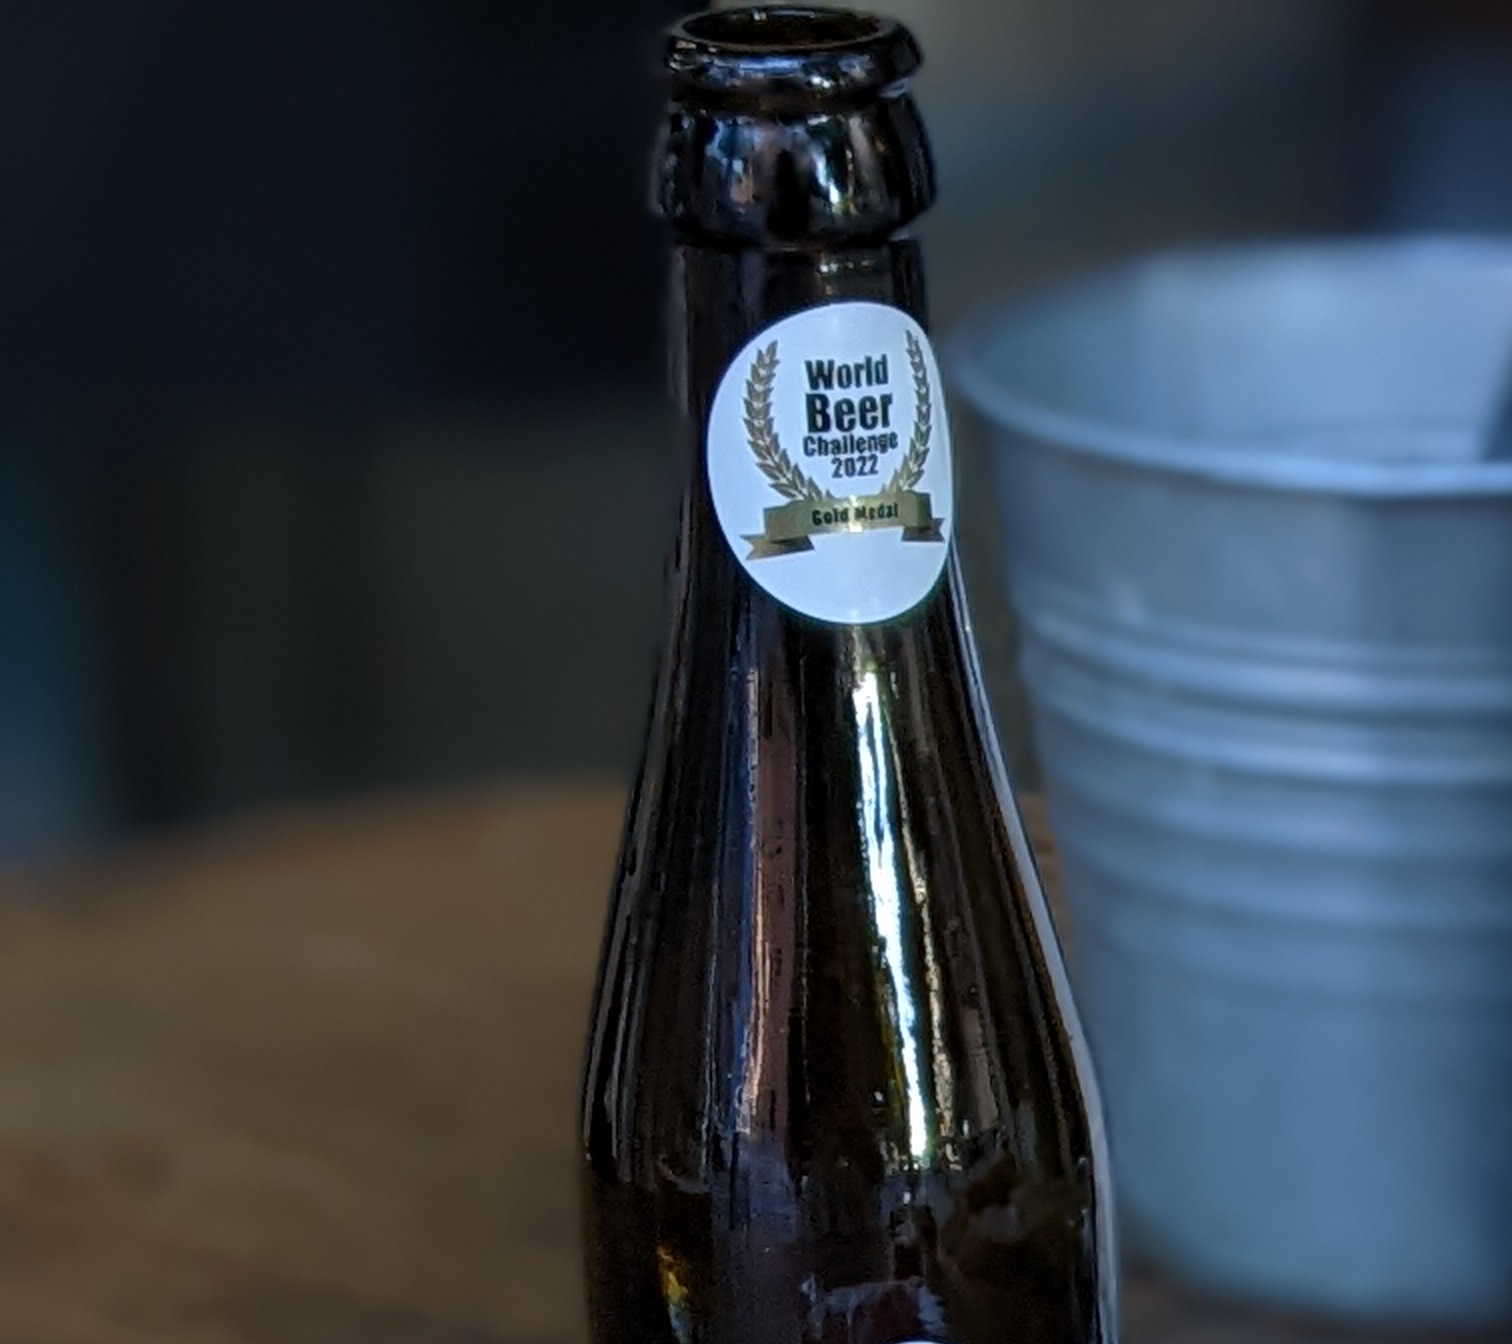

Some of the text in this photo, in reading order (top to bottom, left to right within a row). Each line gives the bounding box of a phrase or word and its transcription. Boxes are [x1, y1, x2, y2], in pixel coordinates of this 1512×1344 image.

[805, 354, 889, 391] World
[805, 393, 893, 434] Beer
[803, 431, 899, 458] Challenge
[831, 454, 879, 479] 2022
[811, 501, 899, 526] Gold Medal
